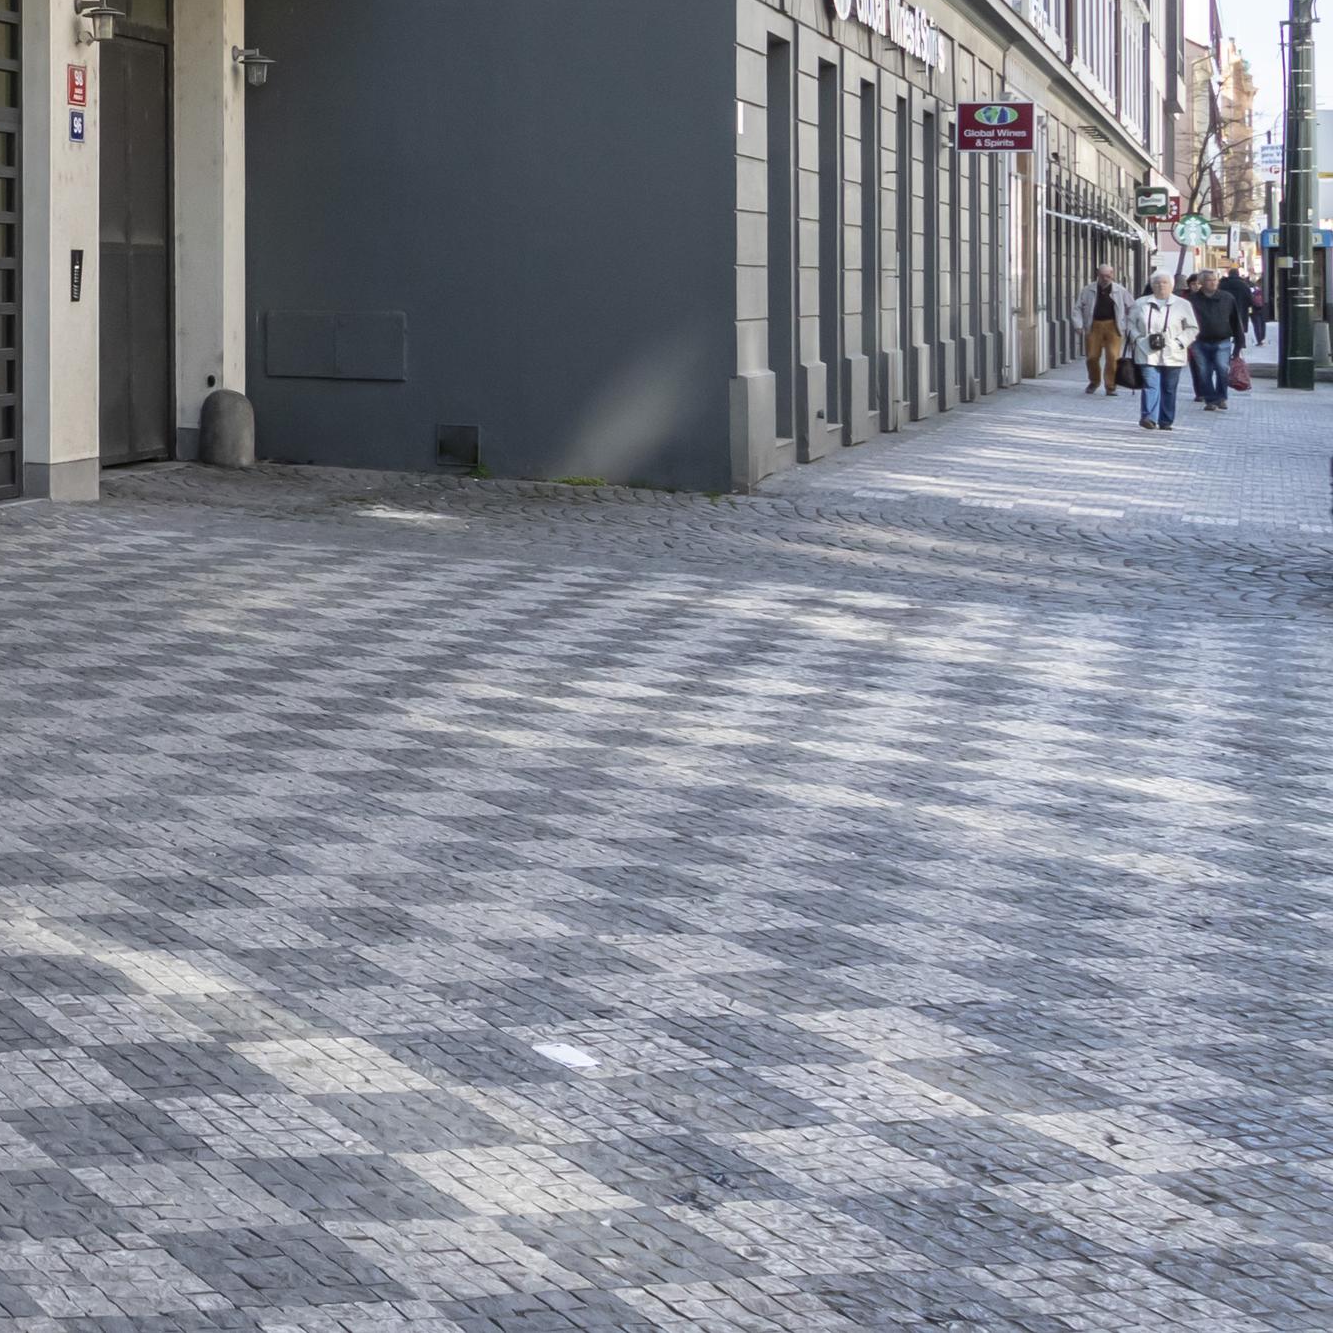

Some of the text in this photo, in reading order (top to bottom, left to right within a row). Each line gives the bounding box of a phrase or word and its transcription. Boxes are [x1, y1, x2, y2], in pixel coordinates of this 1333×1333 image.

[963, 129, 1027, 137] Global Wines
[975, 138, 1015, 148] & Spirits
